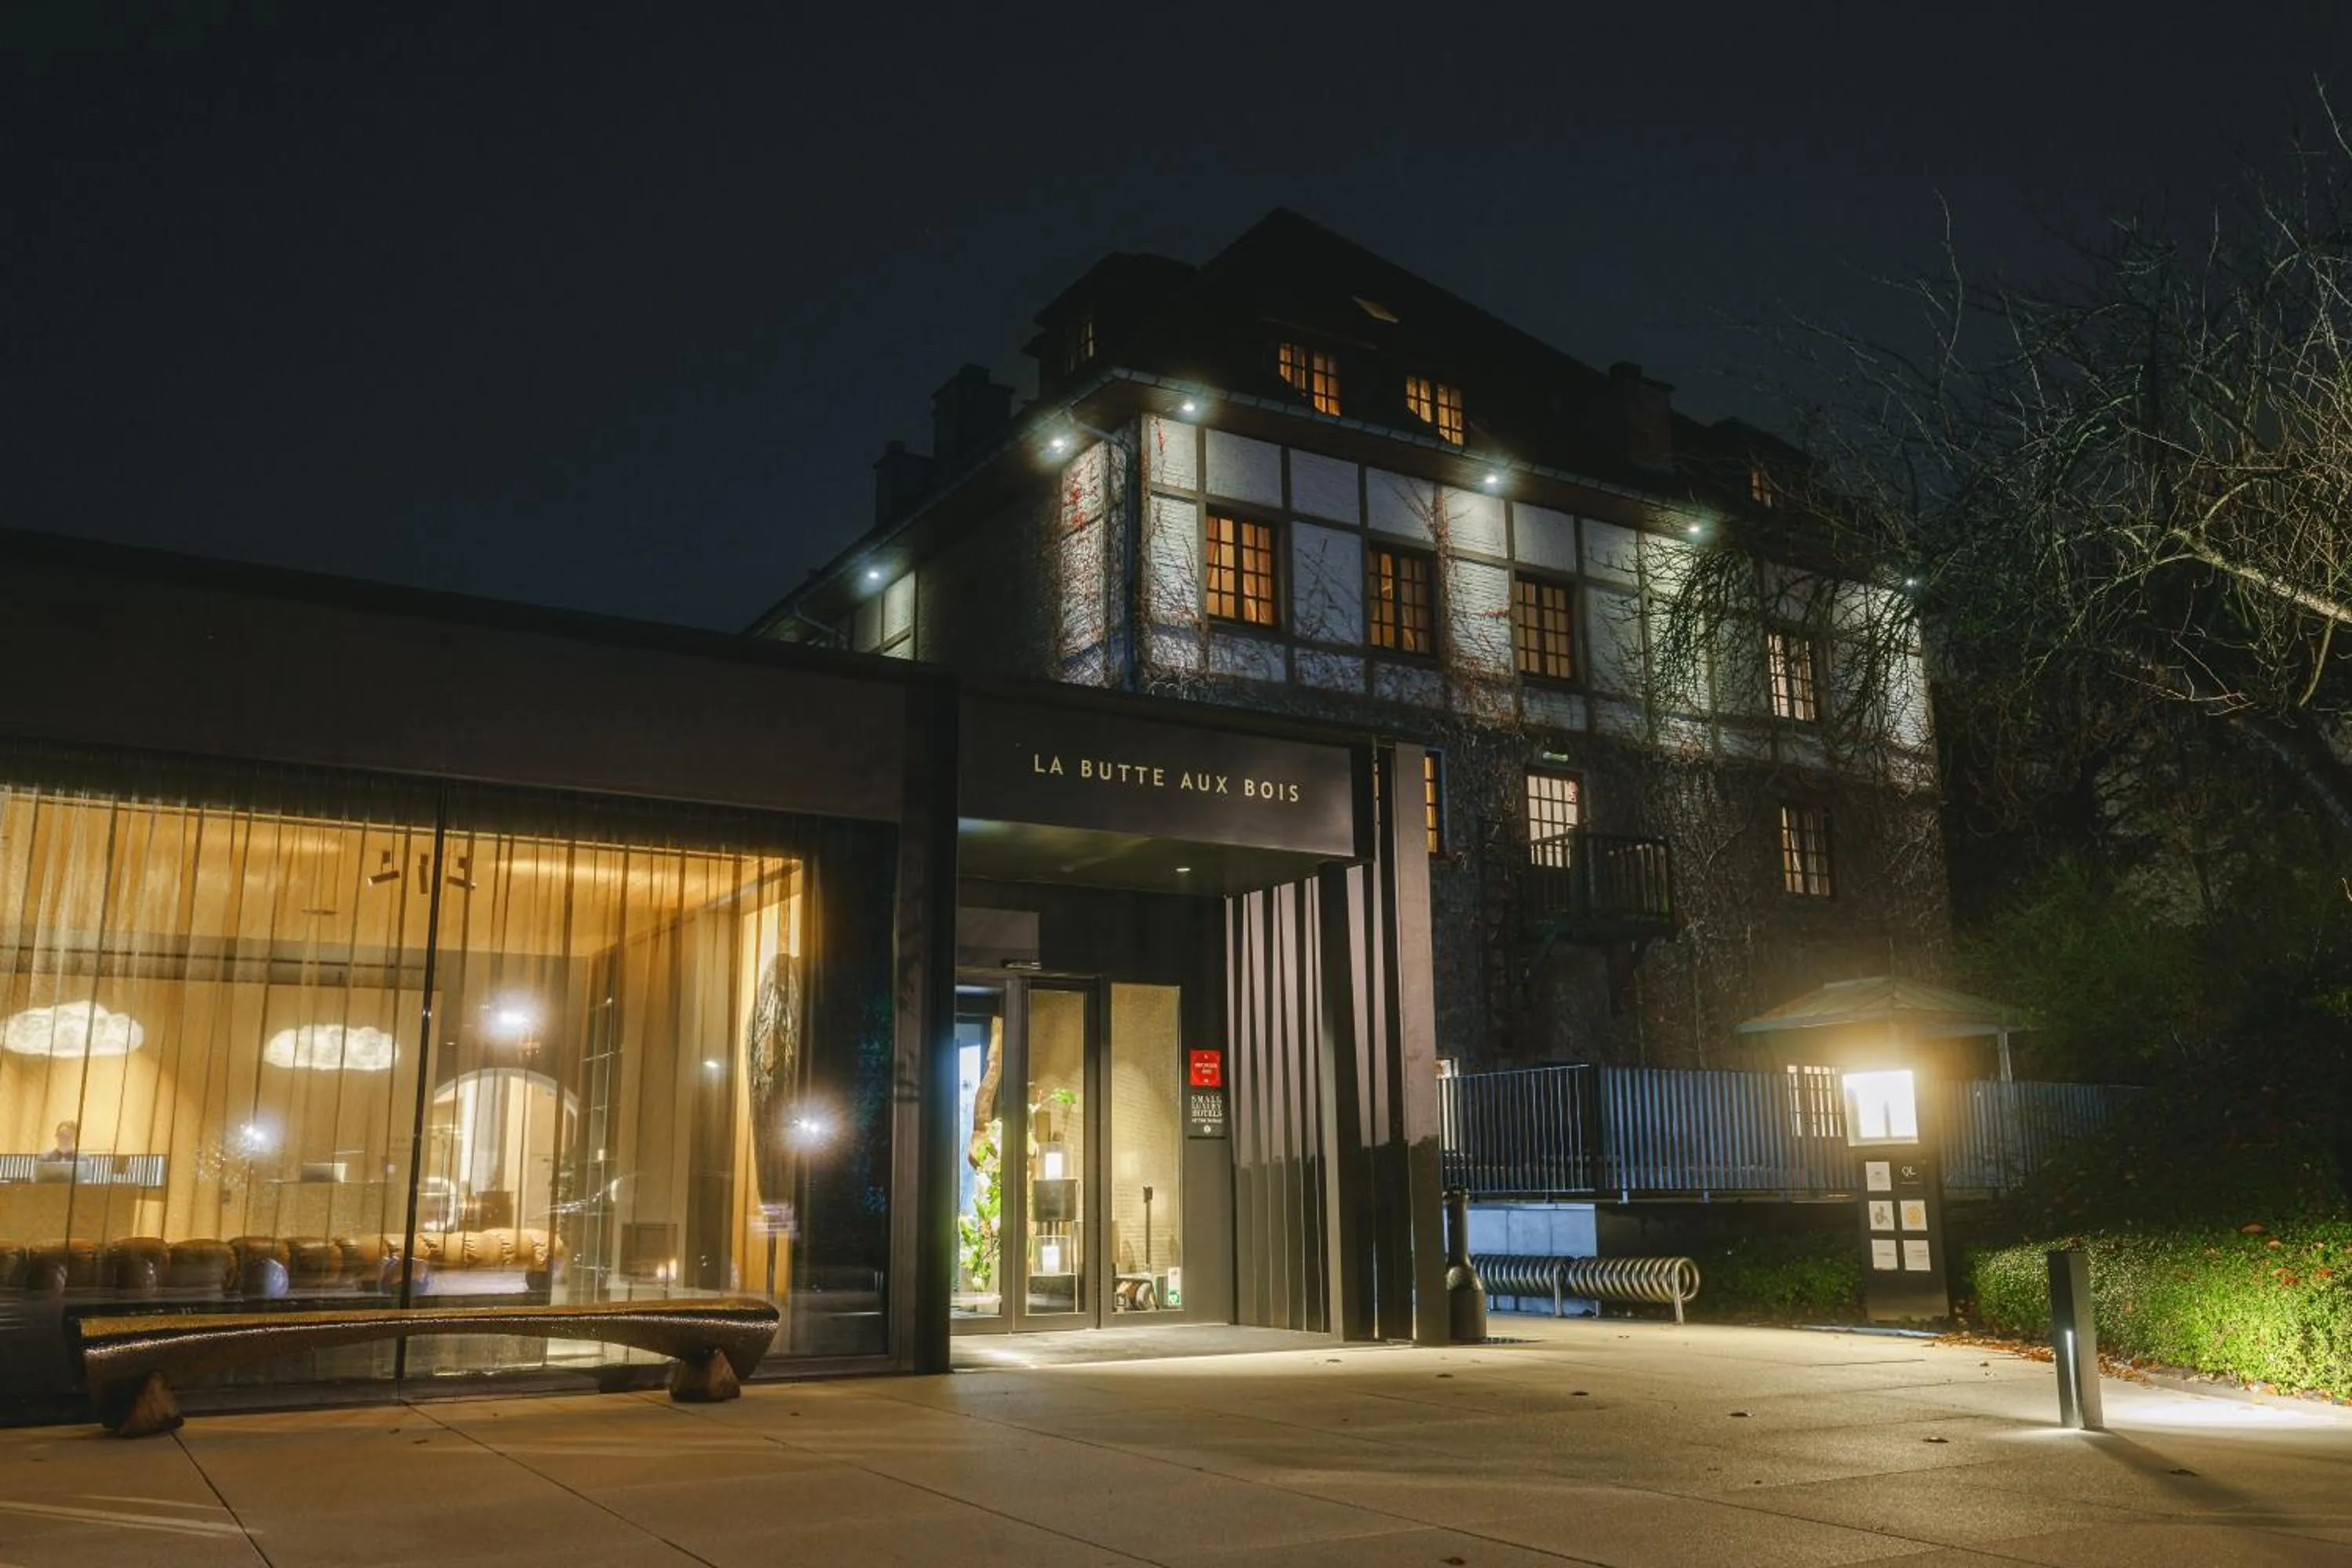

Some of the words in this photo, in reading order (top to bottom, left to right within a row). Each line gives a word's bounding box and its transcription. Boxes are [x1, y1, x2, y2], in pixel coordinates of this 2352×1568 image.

[1033, 753, 1064, 775] LA
[1080, 759, 1165, 786] BUTTE
[1180, 771, 1229, 794] AUX
[1244, 779, 1299, 802] BOIS
